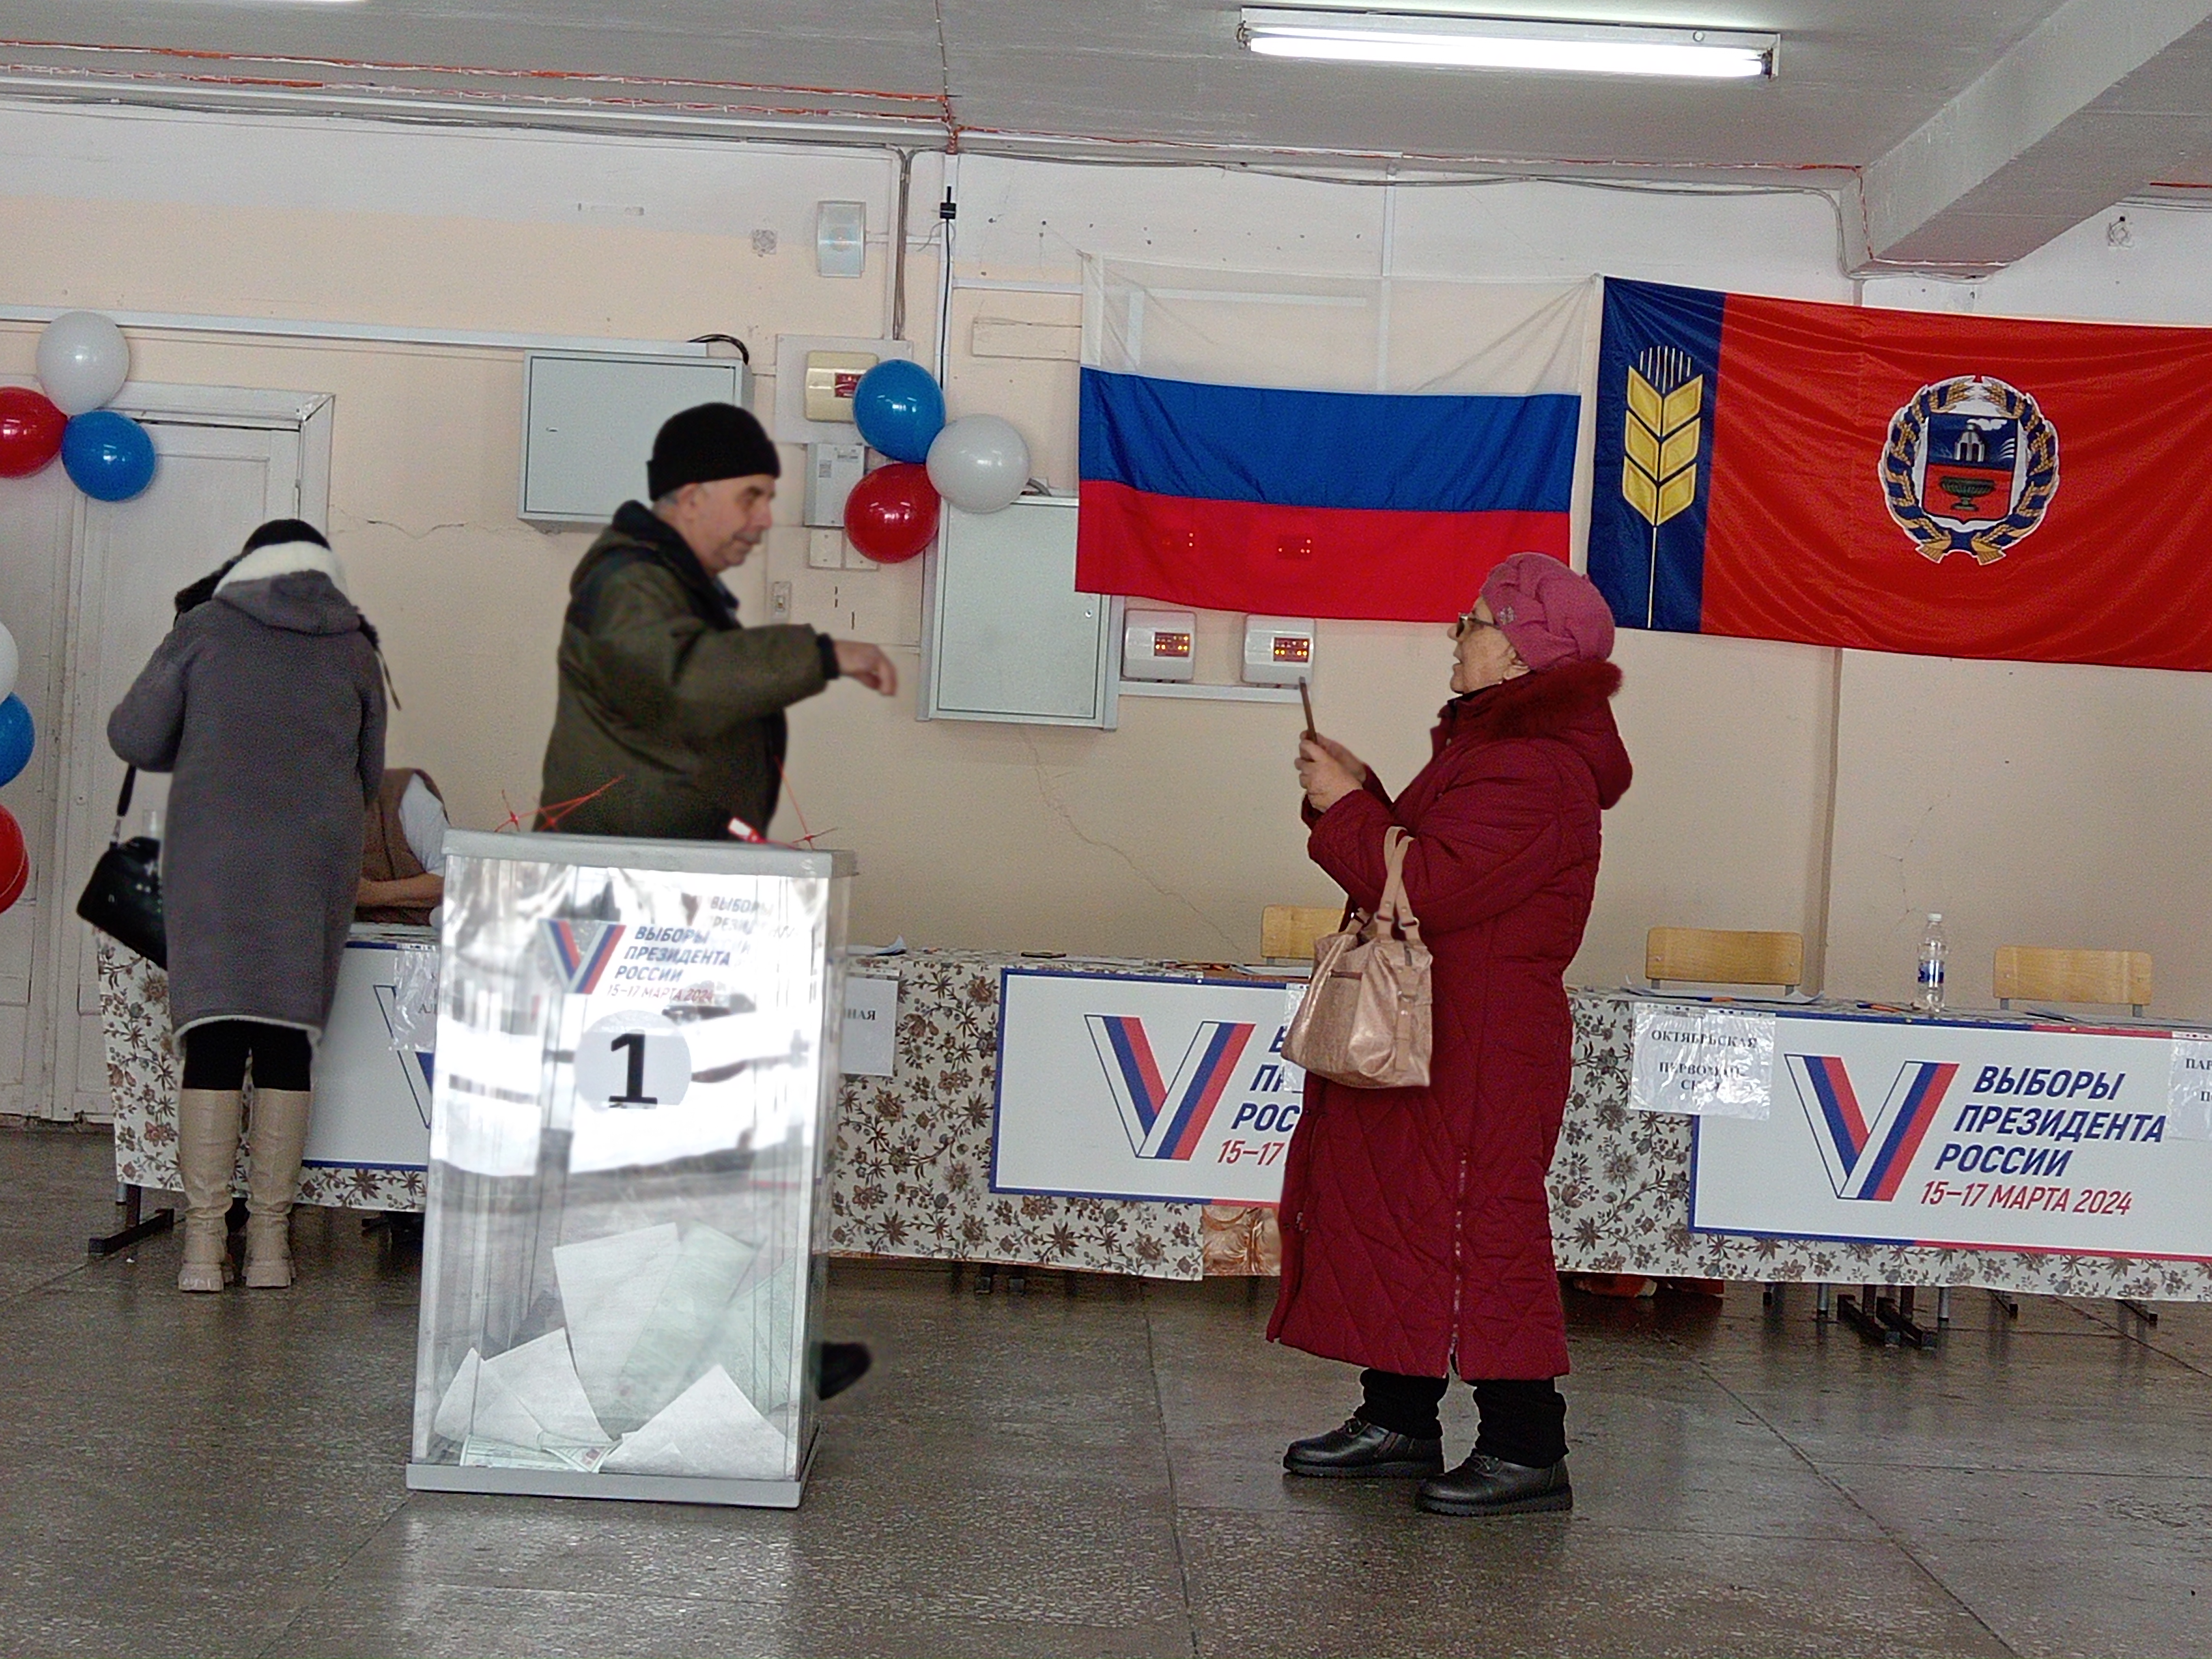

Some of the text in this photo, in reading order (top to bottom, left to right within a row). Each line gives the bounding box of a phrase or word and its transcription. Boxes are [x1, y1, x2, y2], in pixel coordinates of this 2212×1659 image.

[634, 926, 711, 944] ВЫБОРЫ
[624, 946, 731, 966] ПРЕЗИДЕНТА
[614, 965, 684, 983] РОССИИ
[641, 986, 682, 1001] МАРТА
[683, 988, 715, 1003] 2024
[1651, 1029, 1757, 1048] ОКТЯБРЬСКАЯ
[608, 1029, 658, 1106] 1
[1973, 1066, 2126, 1101] ВЫБОРЫ
[1231, 1103, 1300, 1132] РОС
[1953, 1104, 2167, 1143] ПРЕЗИДЕНТА
[1934, 1143, 2073, 1177] РОССИИ
[1988, 1184, 2070, 1213] МАРТА
[2073, 1188, 2133, 1216] 2024
